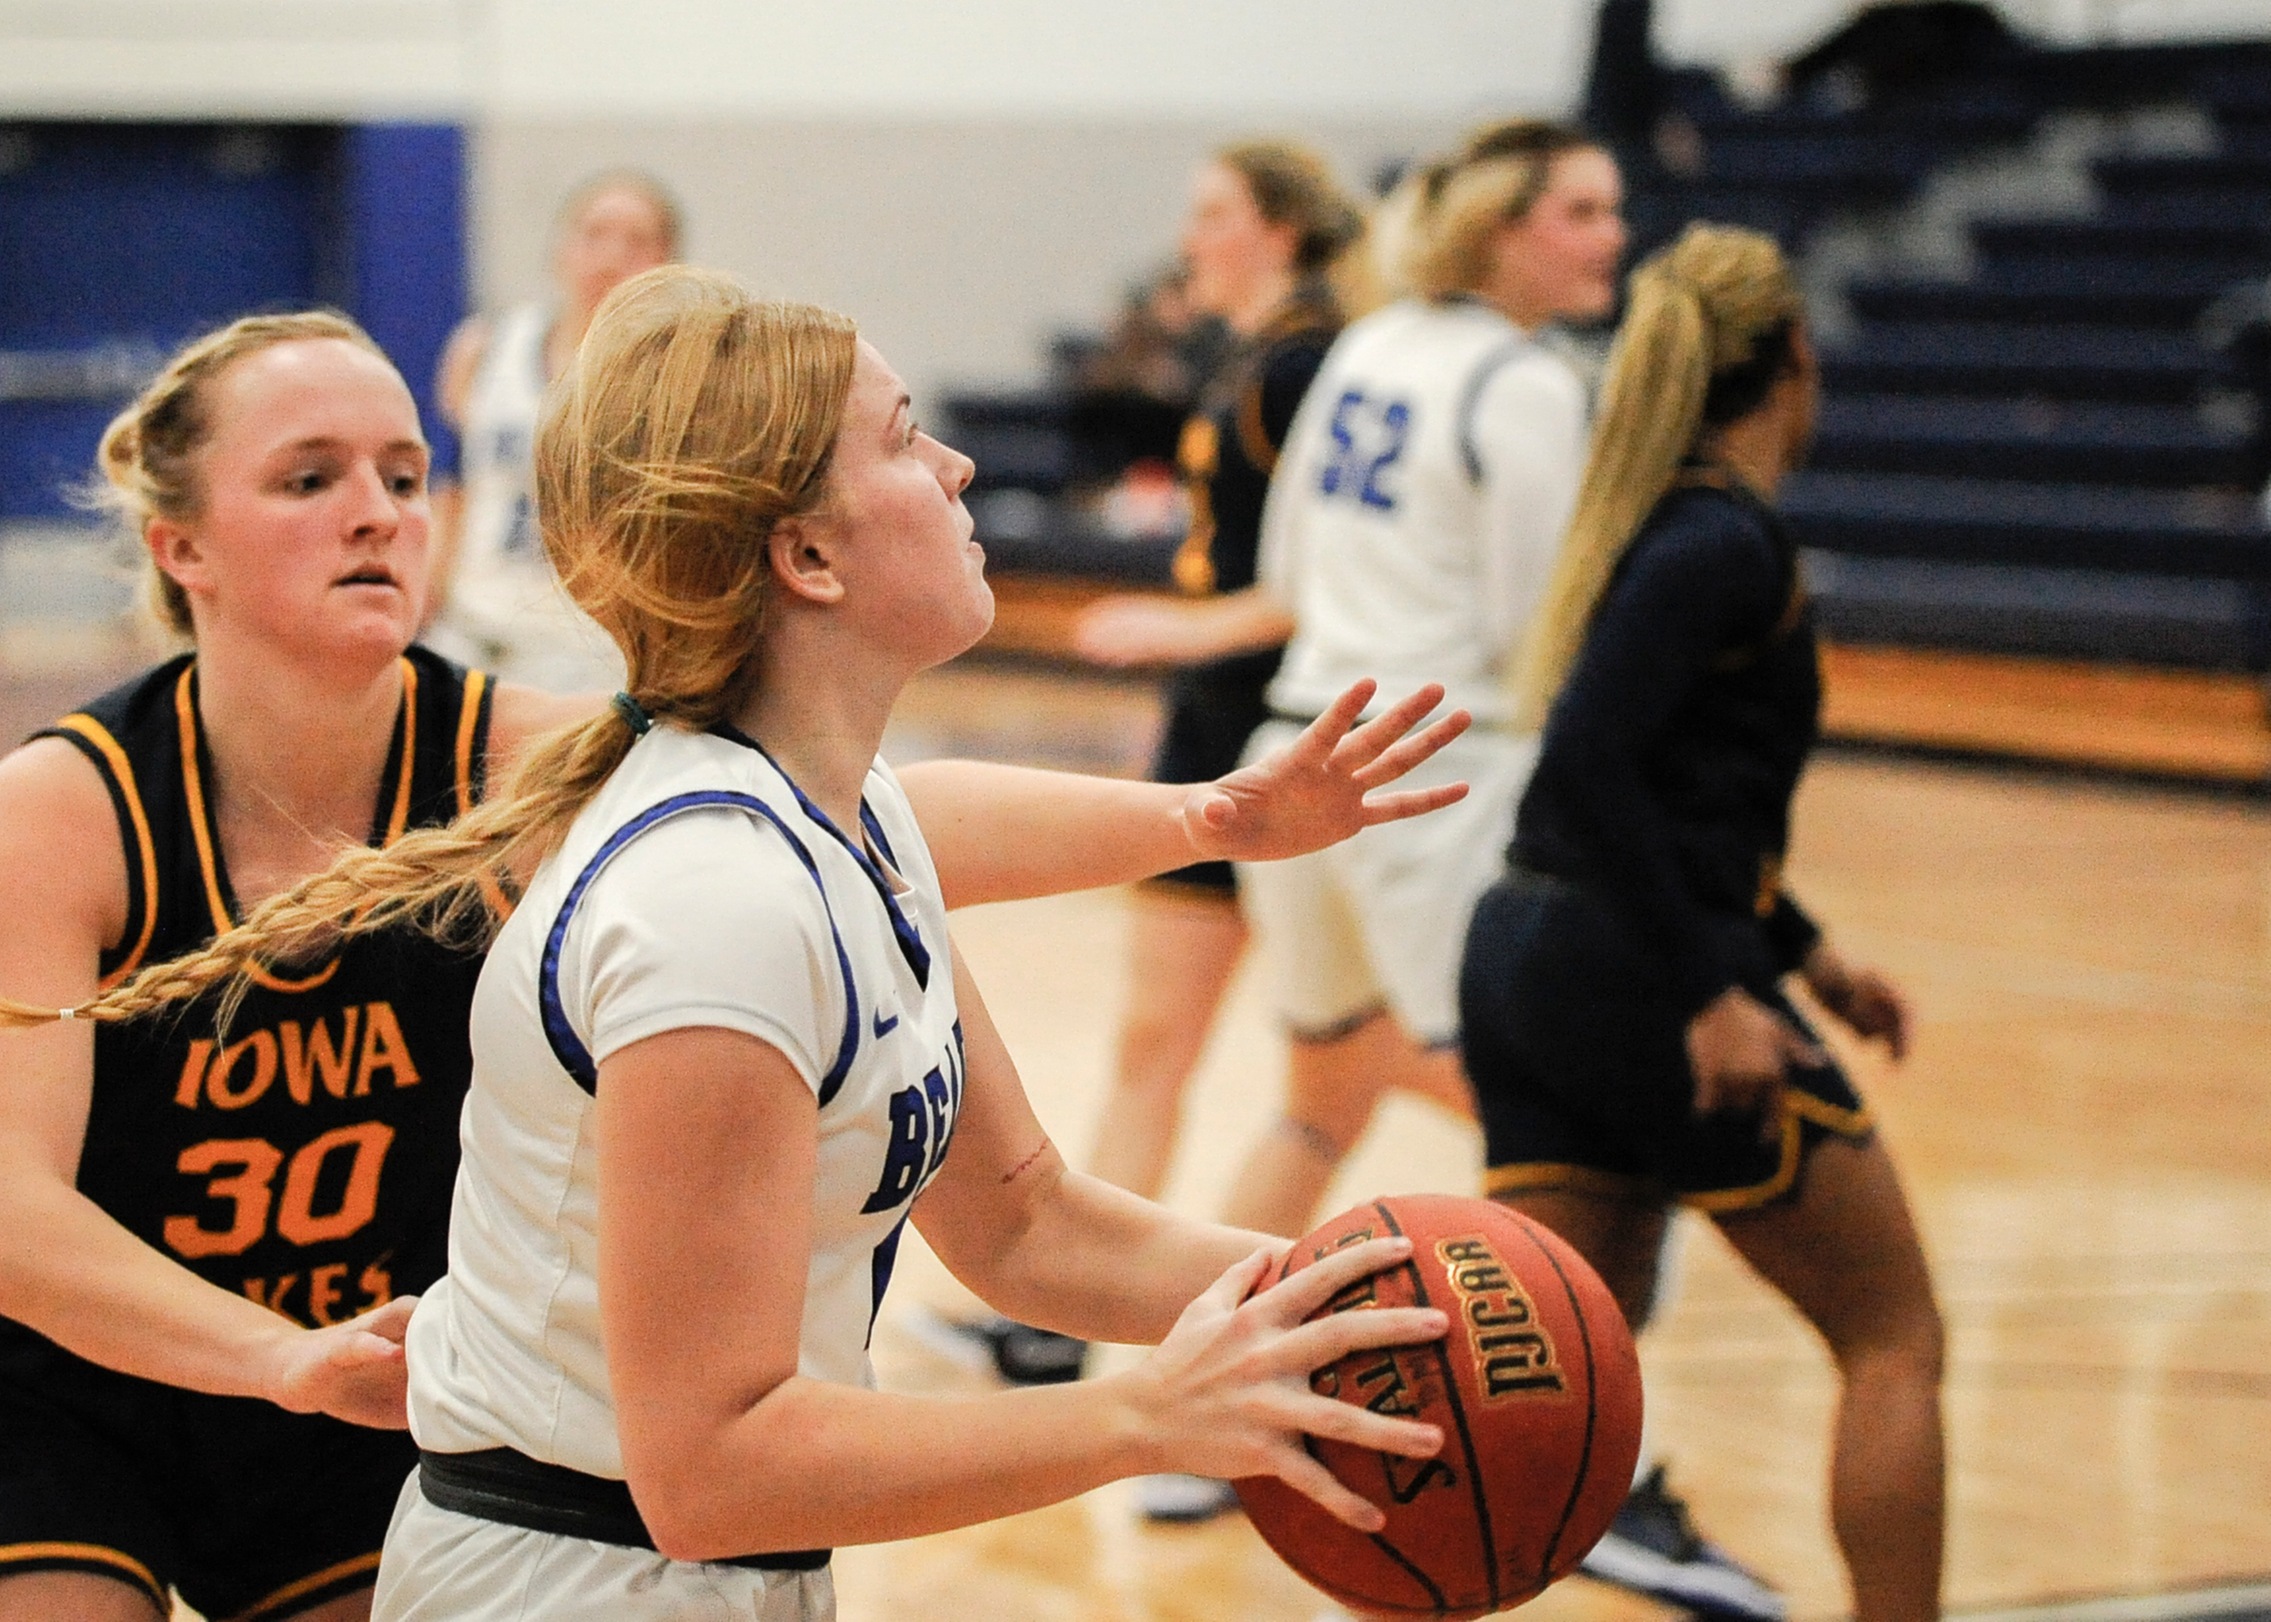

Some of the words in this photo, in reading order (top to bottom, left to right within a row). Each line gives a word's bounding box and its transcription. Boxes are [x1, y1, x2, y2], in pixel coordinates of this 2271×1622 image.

[1322, 390, 1410, 512] 52
[174, 1000, 422, 1111] IOWA
[860, 1018, 967, 1216] BE
[162, 1119, 397, 1260] 30
[243, 1262, 393, 1330] KES
[1440, 1237, 1567, 1400] NJCAA
